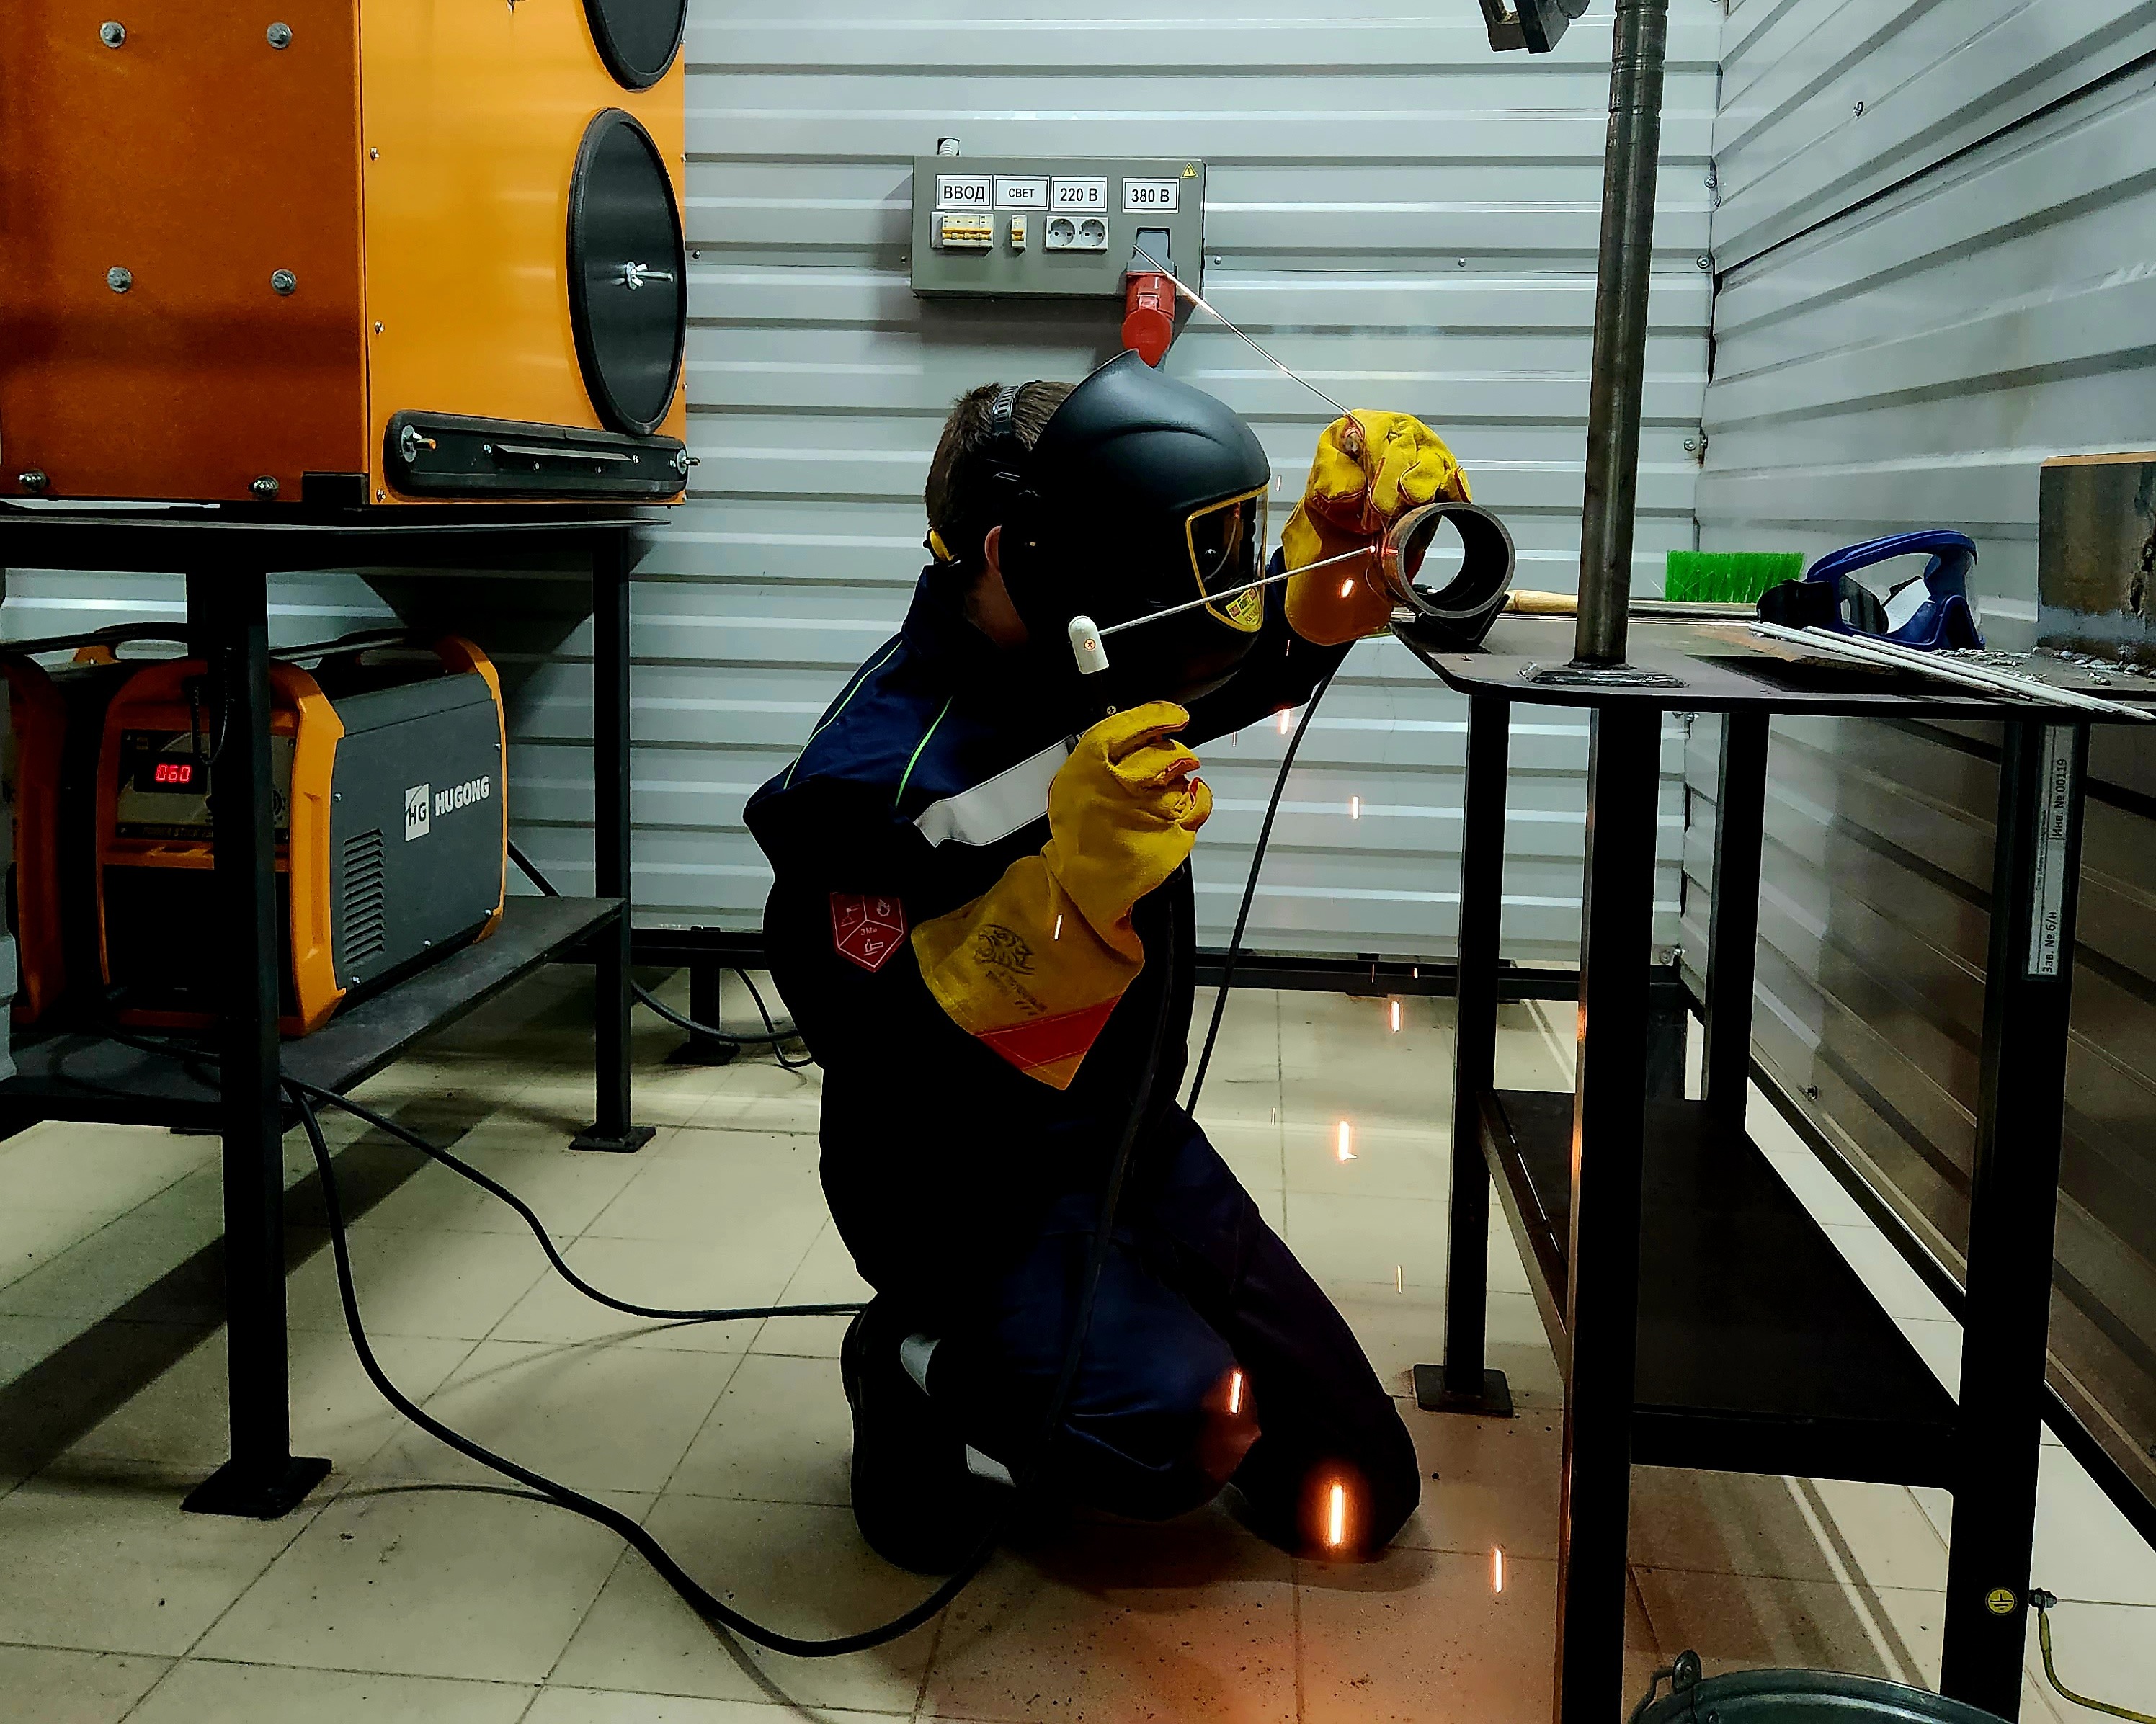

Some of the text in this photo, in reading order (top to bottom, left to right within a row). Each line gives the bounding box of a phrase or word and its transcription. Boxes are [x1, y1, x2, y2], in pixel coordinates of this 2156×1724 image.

[943, 185, 985, 202] ВВОД
[1008, 187, 1035, 199] СВЕТ
[1060, 187, 1098, 202] 220 В
[1131, 189, 1170, 203] 380 В
[155, 764, 192, 782] 060
[2055, 759, 2067, 793] 00119
[435, 775, 490, 816] HUGONG
[409, 802, 427, 826] HG
[2052, 811, 2064, 837] Инв.
[2042, 951, 2054, 973] Зав.
